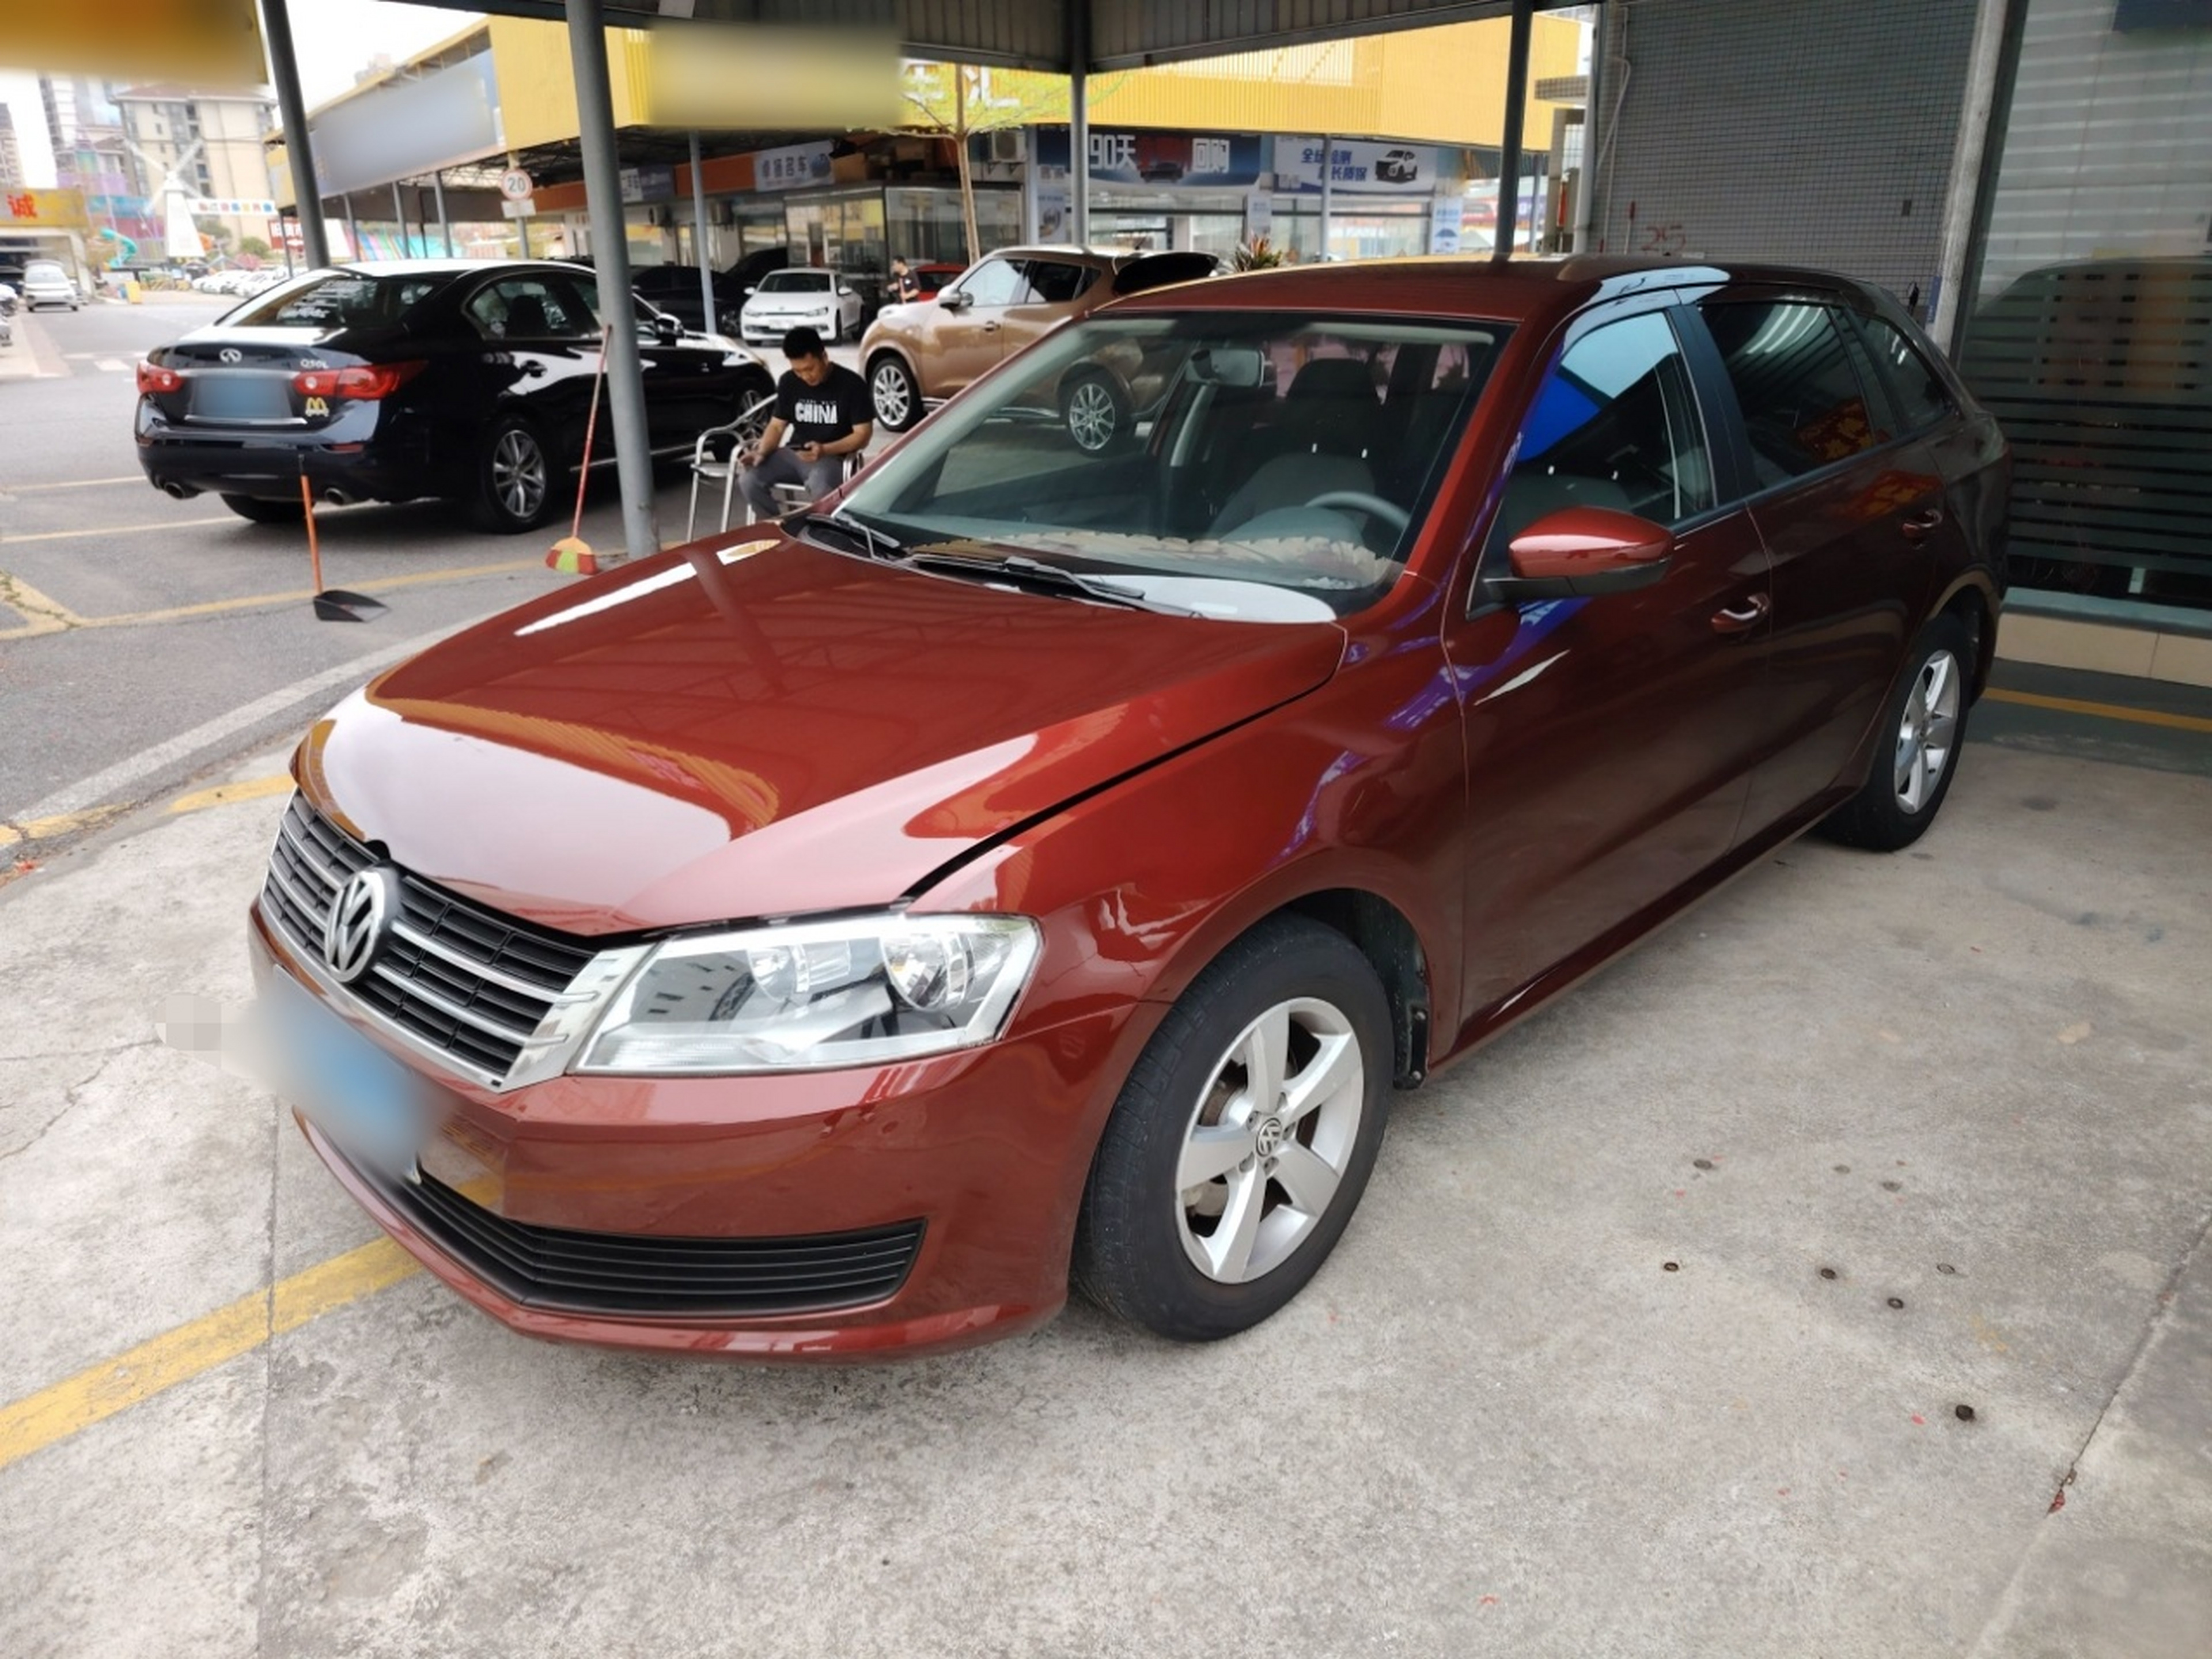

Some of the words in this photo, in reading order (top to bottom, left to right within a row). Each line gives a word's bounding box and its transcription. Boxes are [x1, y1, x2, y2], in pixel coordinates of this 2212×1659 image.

[1089, 135, 1139, 171] 90天
[507, 177, 526, 193] 20
[7, 194, 37, 219] 诚
[301, 359, 329, 369] Q50L
[795, 402, 838, 424] CHINA
